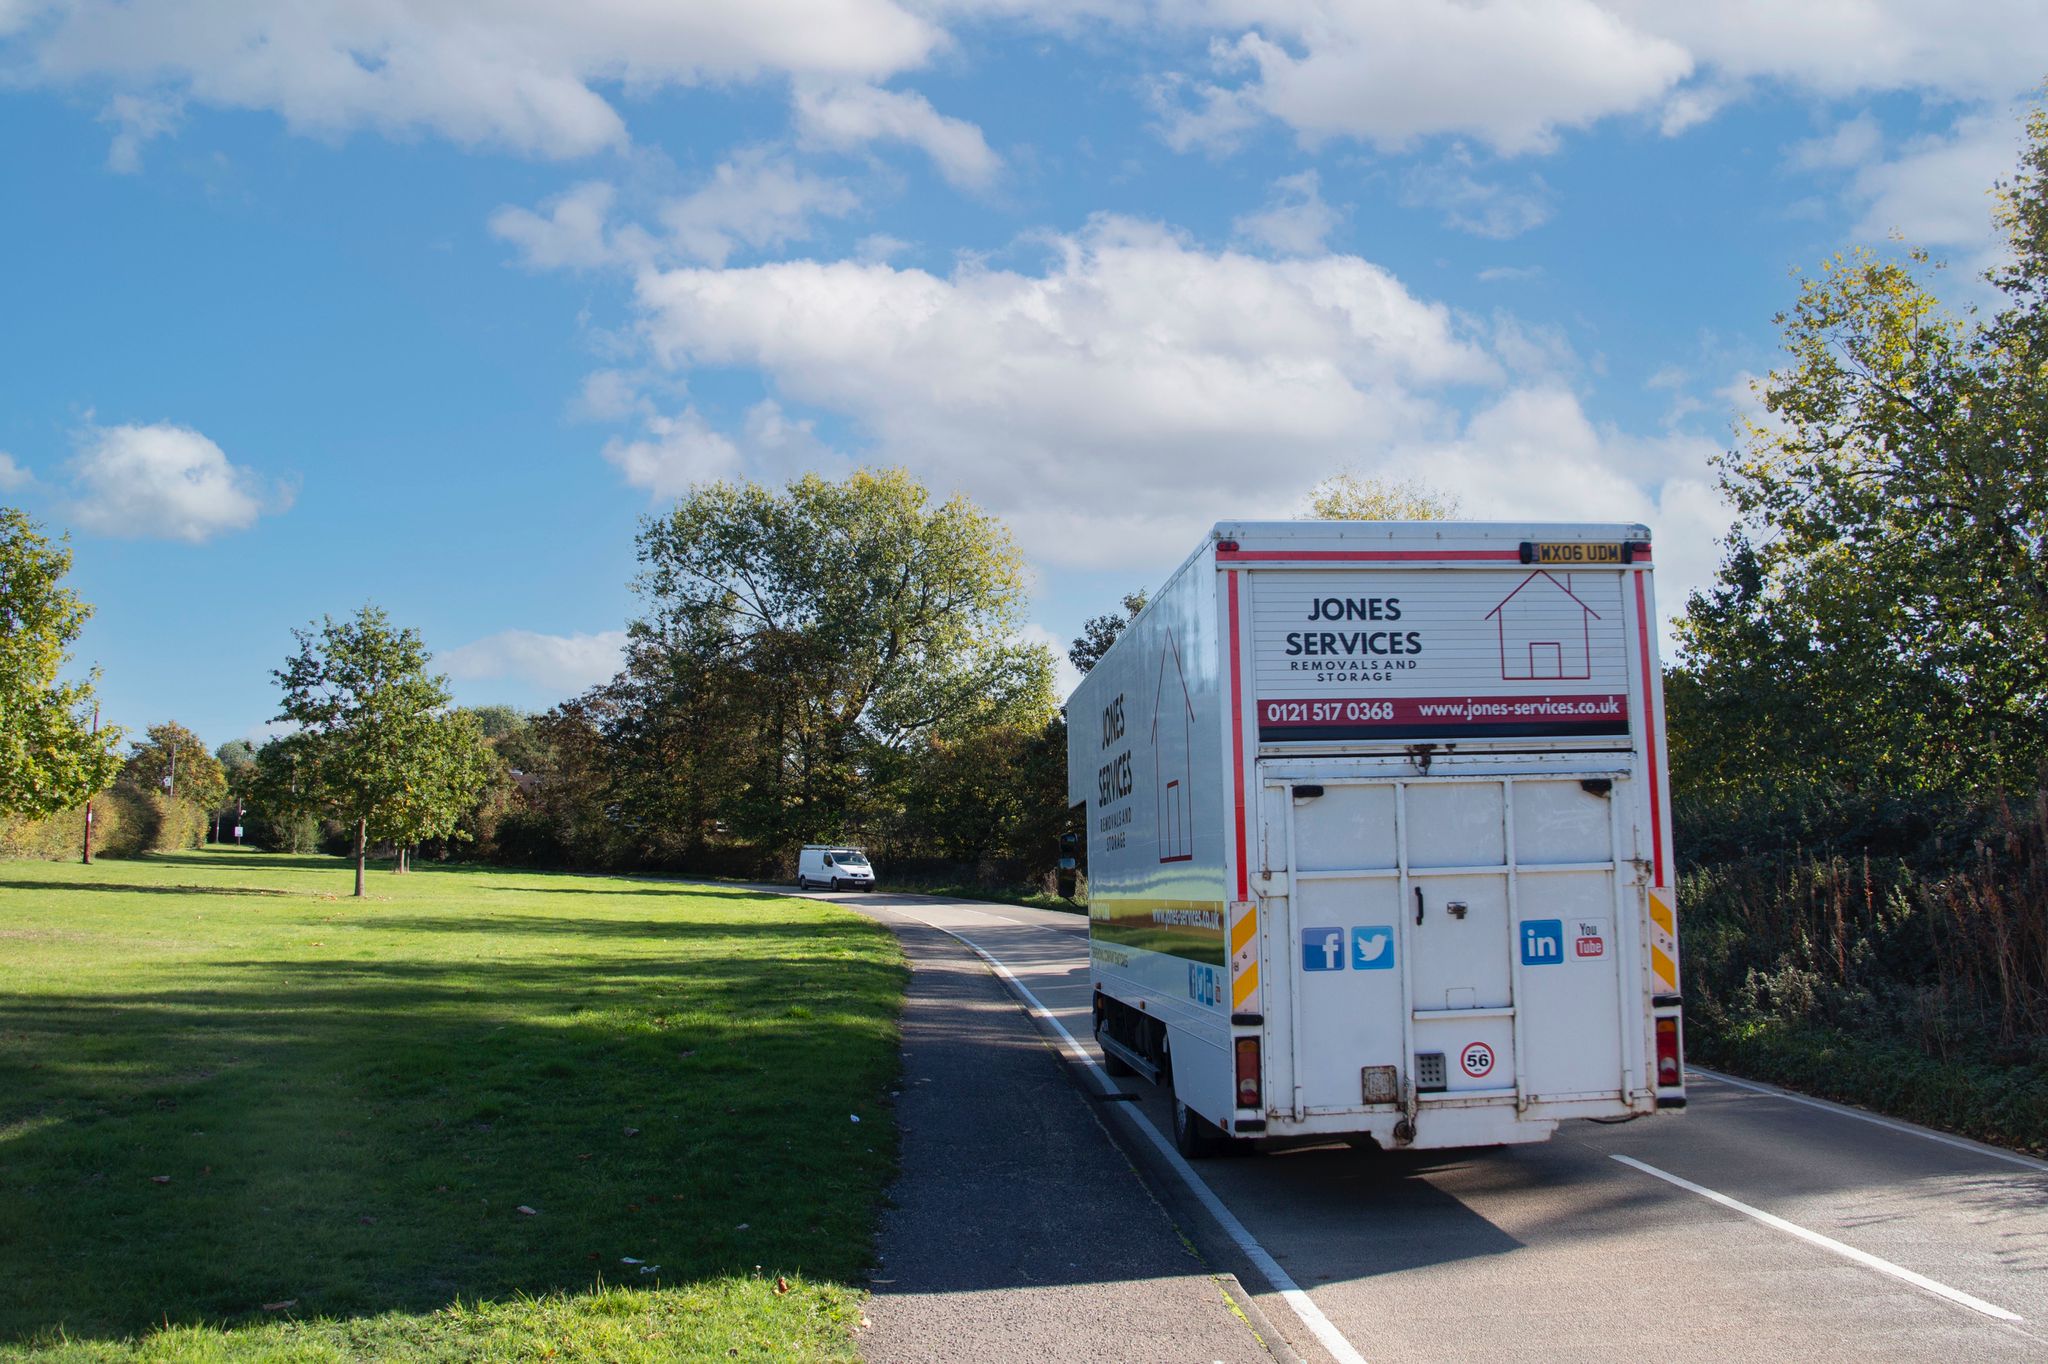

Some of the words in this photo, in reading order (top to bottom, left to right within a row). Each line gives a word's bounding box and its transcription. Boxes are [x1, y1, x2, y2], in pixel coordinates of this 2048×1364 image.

[1541, 545, 1583, 561] WX06
[1587, 545, 1619, 560] UDM
[1308, 598, 1401, 621] JONES
[1286, 632, 1422, 655] SERVICES
[1291, 661, 1379, 670] REMOVALS
[1385, 661, 1417, 670] AND
[1317, 672, 1392, 682] STORAGE
[1268, 703, 1308, 721] 0121
[1312, 703, 1342, 720] 517
[1347, 702, 1394, 720] 0368
[1419, 696, 1619, 720] www.jones-services.co.uk
[1102, 693, 1125, 750] JONES
[1099, 750, 1132, 808] SERVICES
[1100, 809, 1121, 833] REMOVALS
[1122, 806, 1131, 824] AND
[1106, 832, 1126, 852] STORAGE
[1579, 923, 1598, 936] You
[1527, 929, 1557, 957] in
[1576, 940, 1602, 955] Tube
[1467, 1054, 1489, 1067] 56
